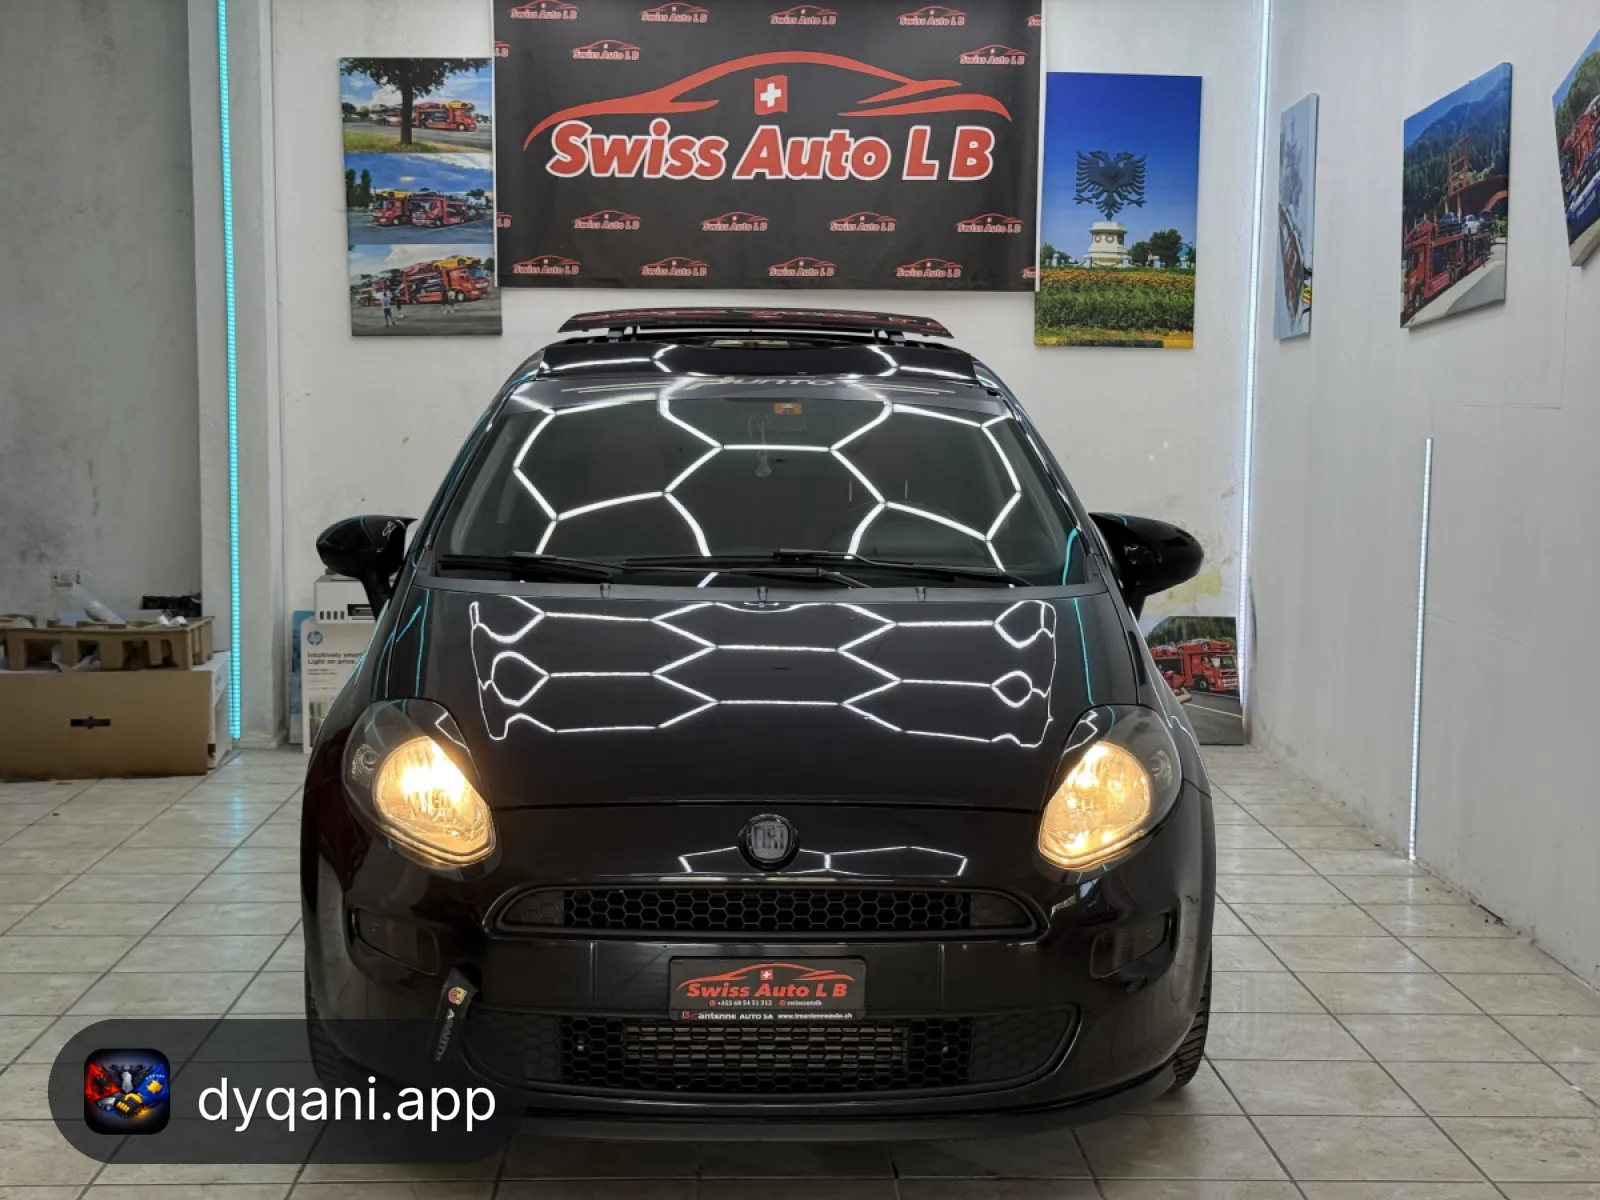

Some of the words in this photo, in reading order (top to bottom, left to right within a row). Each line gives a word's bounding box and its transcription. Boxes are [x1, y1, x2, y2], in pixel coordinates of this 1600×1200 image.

[511, 8, 538, 19] Swiss
[538, 9, 561, 20] Auto
[641, 11, 668, 22] Swiss
[668, 12, 691, 23] Auto
[771, 14, 798, 25] Swiss
[797, 15, 821, 25] Auto
[899, 15, 926, 25] Swiss
[925, 16, 949, 25] Auto
[573, 49, 600, 59] Swiss
[600, 50, 623, 60] Auto
[960, 54, 986, 64] Swiss
[986, 55, 1009, 64] Auto
[546, 118, 728, 181] Swiss
[732, 125, 891, 180] Auto
[902, 125, 939, 180] L
[948, 126, 995, 181] B
[574, 219, 601, 229] Swiss
[601, 220, 624, 230] Auto
[703, 221, 730, 231] Swiss
[729, 222, 753, 231] Auto
[830, 221, 857, 231] Swiss
[856, 222, 880, 231] Auto
[957, 222, 983, 232] Swiss
[983, 223, 1006, 232] Auto
[513, 264, 540, 274] Swiss
[540, 265, 563, 275] Auto
[642, 266, 669, 276] Swiss
[668, 267, 692, 276] Auto
[769, 266, 796, 276] Swiss
[795, 267, 819, 276] Auto
[896, 267, 923, 277] Swiss
[922, 268, 946, 277] Auto
[687, 982, 750, 997] Swiss
[754, 983, 810, 997] Auto
[816, 983, 827, 997] L
[832, 983, 848, 997] B
